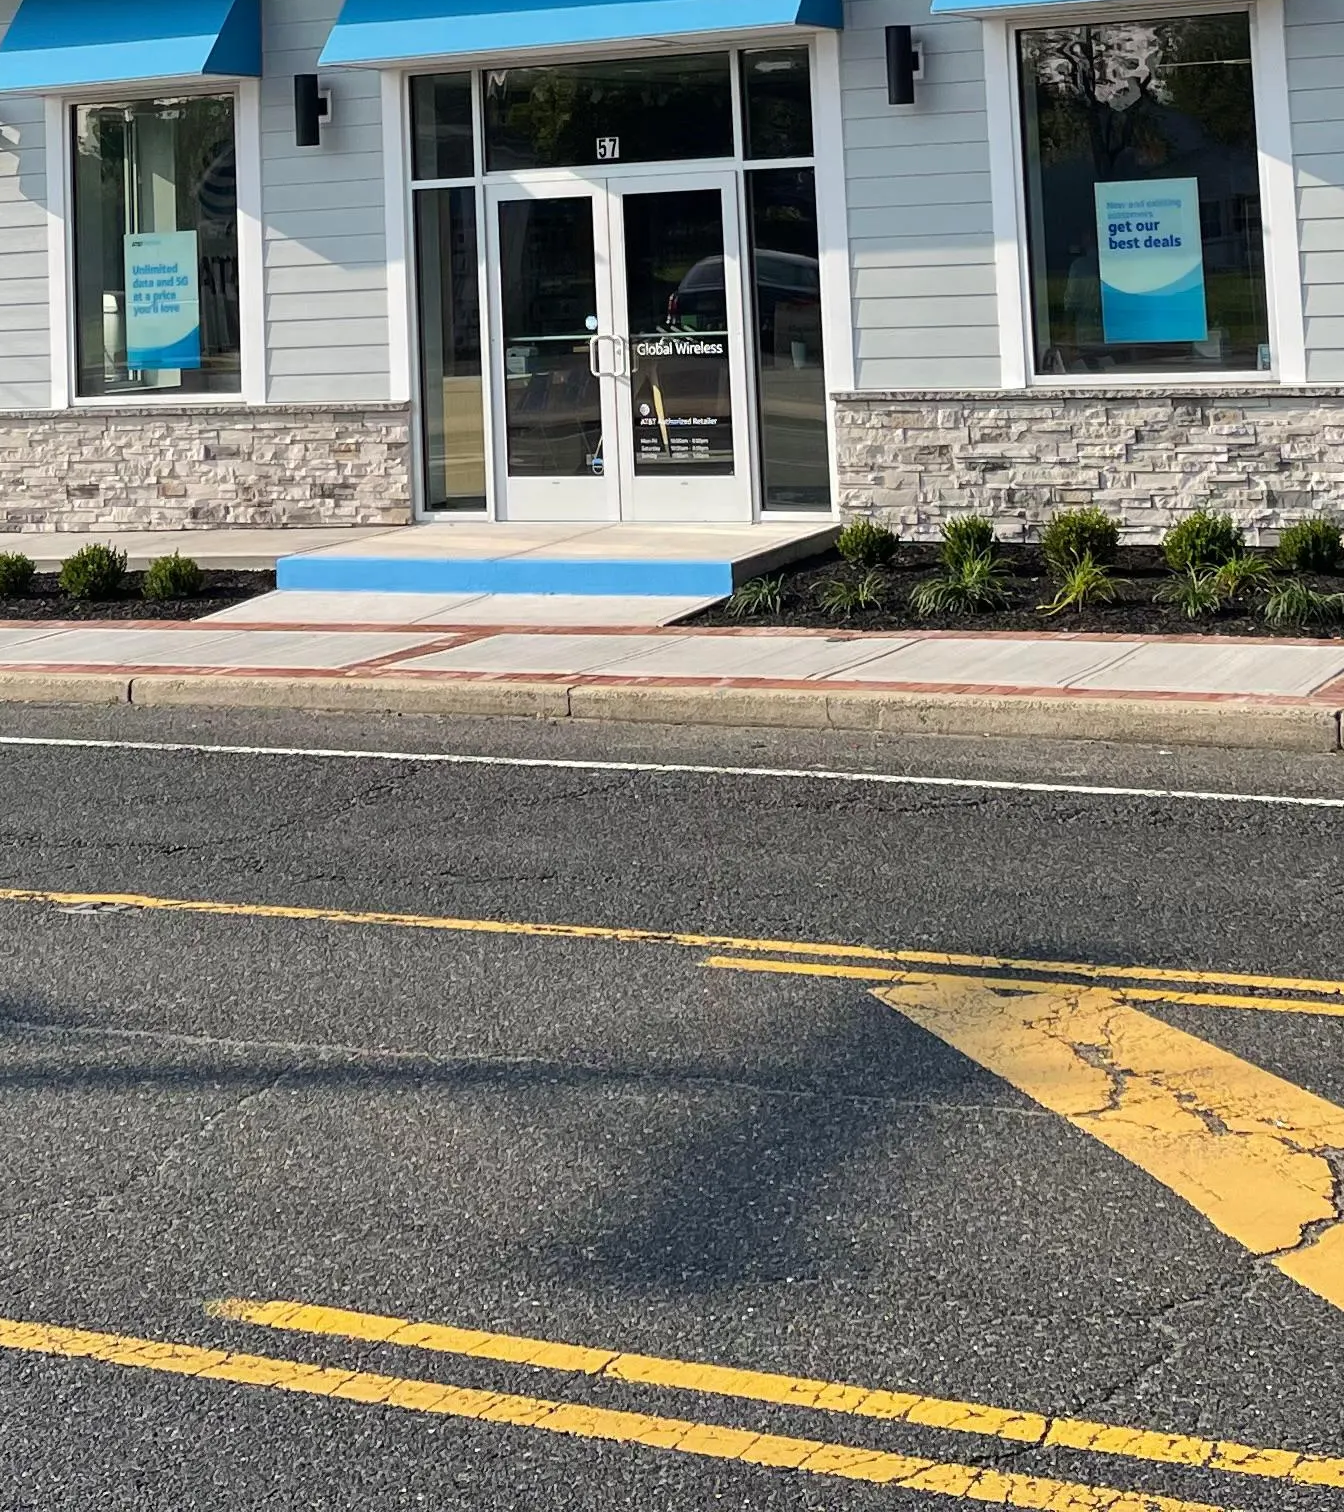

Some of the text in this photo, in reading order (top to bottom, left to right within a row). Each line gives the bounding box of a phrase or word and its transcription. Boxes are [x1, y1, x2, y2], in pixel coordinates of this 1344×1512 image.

[598, 138, 617, 158] 57
[1108, 221, 1160, 236] get our
[1108, 234, 1182, 250] best deals
[132, 262, 179, 275] Unlimited
[132, 275, 189, 288] data and 5G
[133, 292, 143, 302] at
[152, 290, 177, 305] price
[160, 303, 180, 313] love
[636, 340, 724, 356] Global Wireless
[640, 418, 657, 426] AT&T
[692, 417, 718, 425] Retailer
